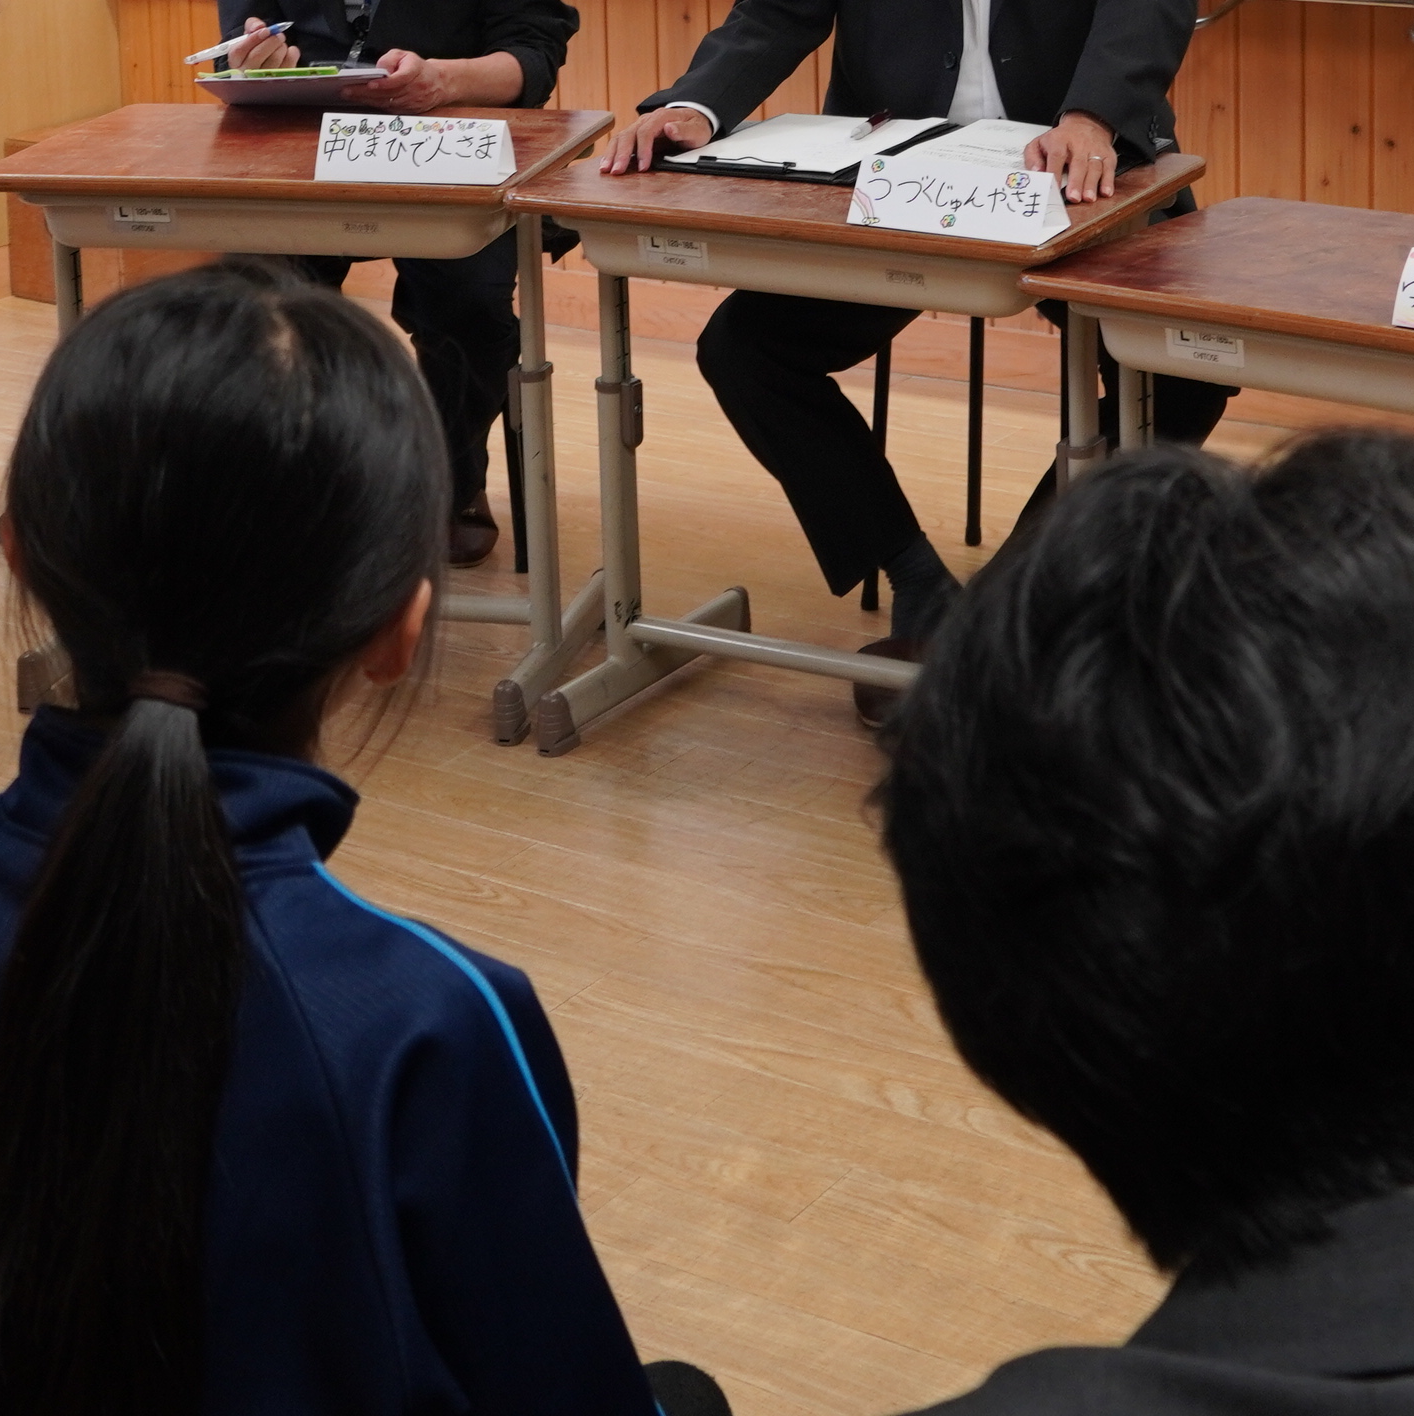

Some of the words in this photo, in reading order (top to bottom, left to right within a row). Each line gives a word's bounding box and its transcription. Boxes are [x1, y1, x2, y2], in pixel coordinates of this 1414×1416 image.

[119, 206, 129, 217] L
[651, 236, 660, 248] L
[1180, 330, 1190, 341] L
